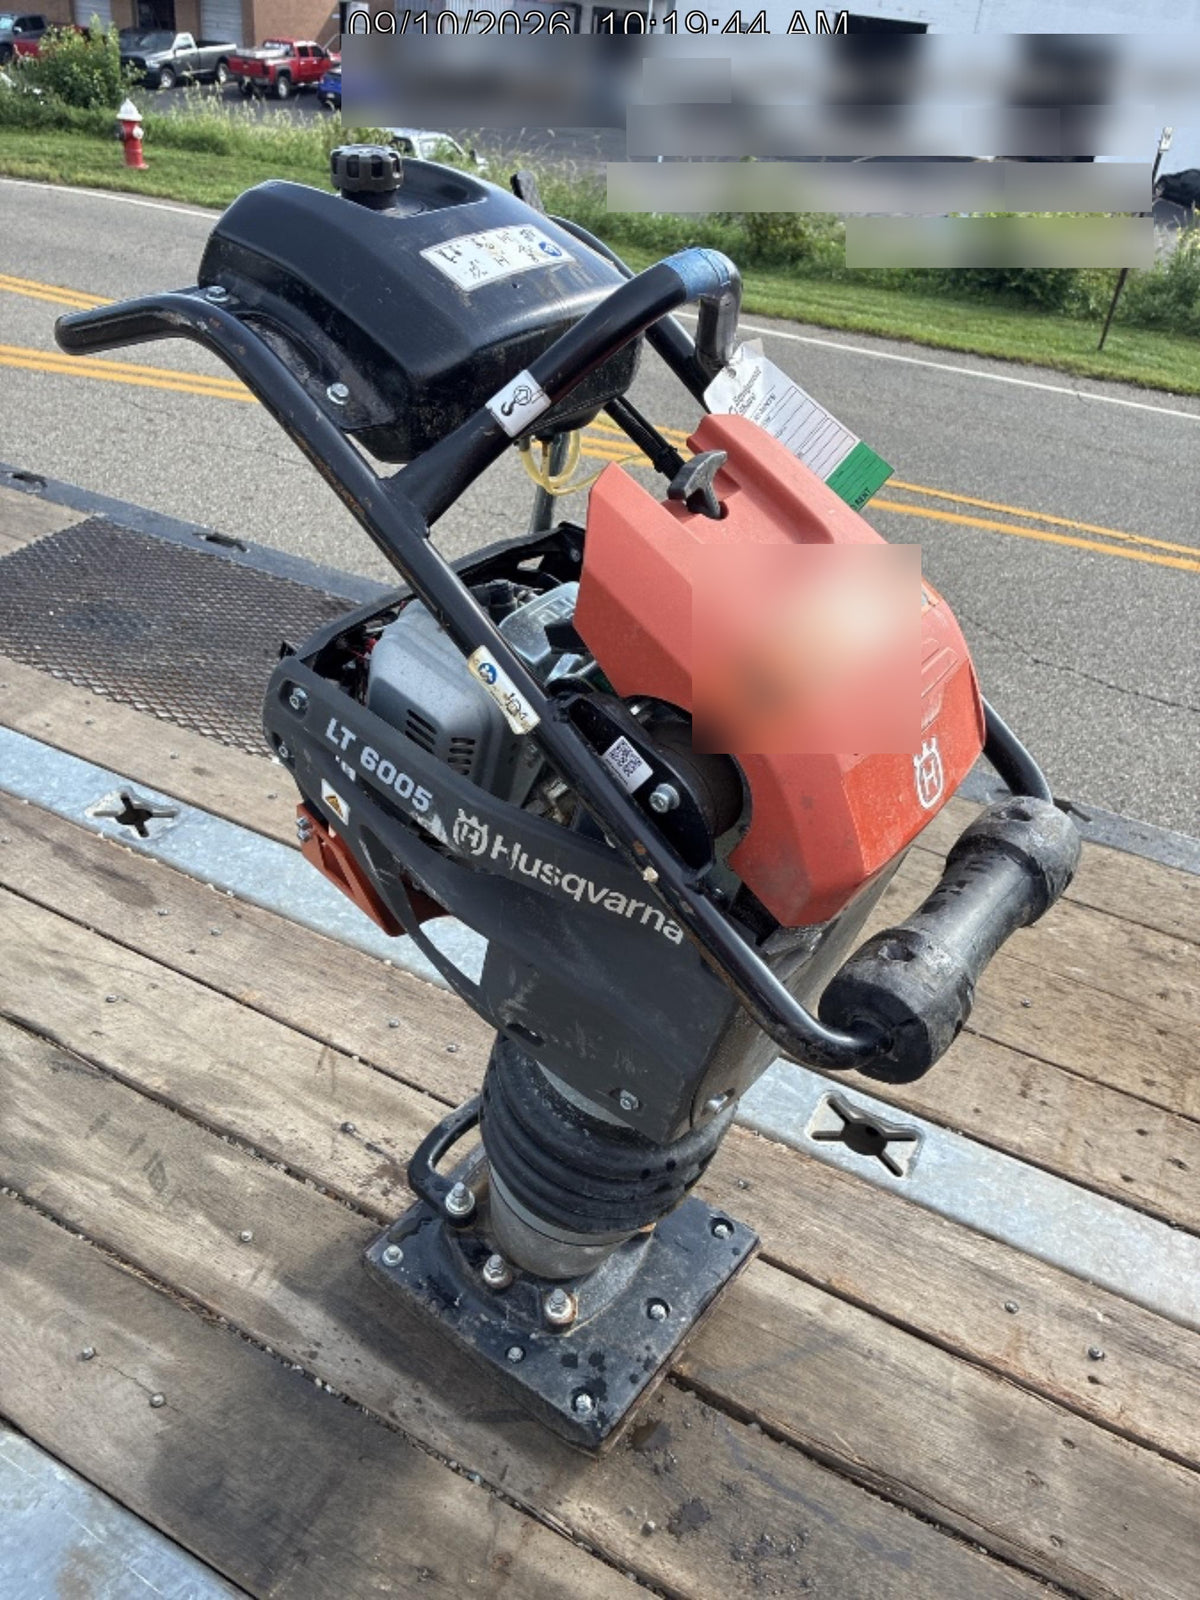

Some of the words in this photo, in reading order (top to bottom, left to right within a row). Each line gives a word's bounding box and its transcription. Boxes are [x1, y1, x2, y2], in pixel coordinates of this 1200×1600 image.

[325, 718, 357, 751] LT
[360, 746, 433, 812] 6005
[490, 833, 684, 945] Husqvarna
